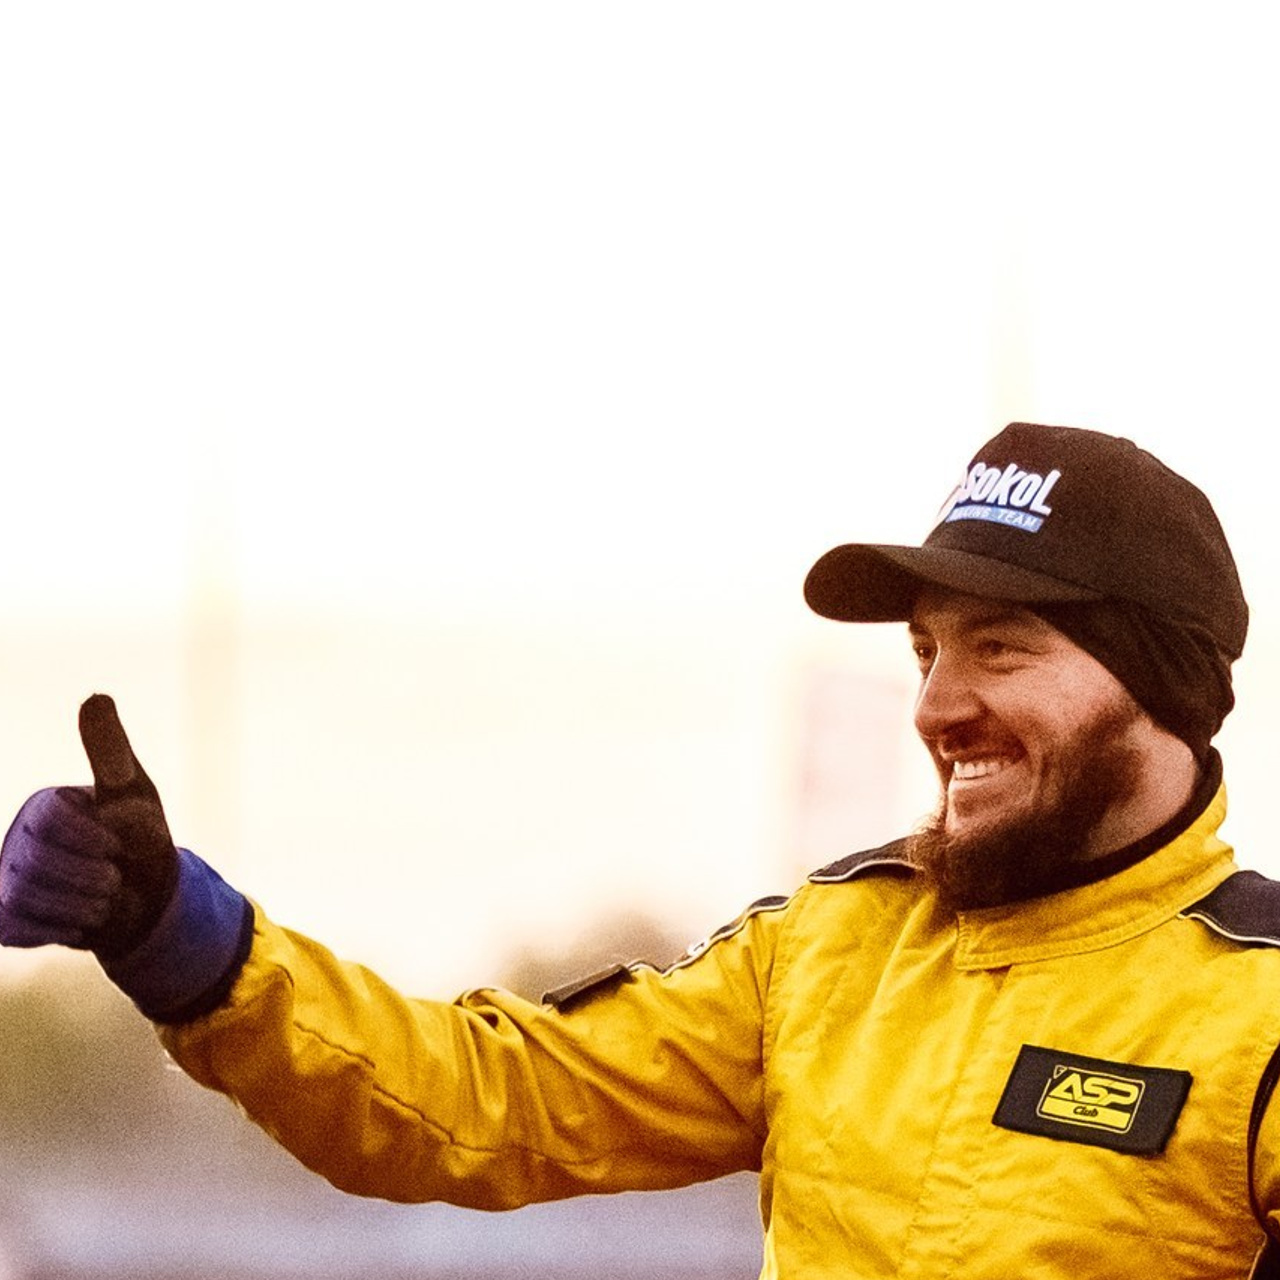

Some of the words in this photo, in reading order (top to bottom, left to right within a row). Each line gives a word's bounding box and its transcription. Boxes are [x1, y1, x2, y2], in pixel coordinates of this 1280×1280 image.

[961, 461, 1062, 516] SOKOL
[997, 507, 1039, 526] TEAM
[1049, 1073, 1140, 1106] ASP
[1073, 1106, 1099, 1118] Club
